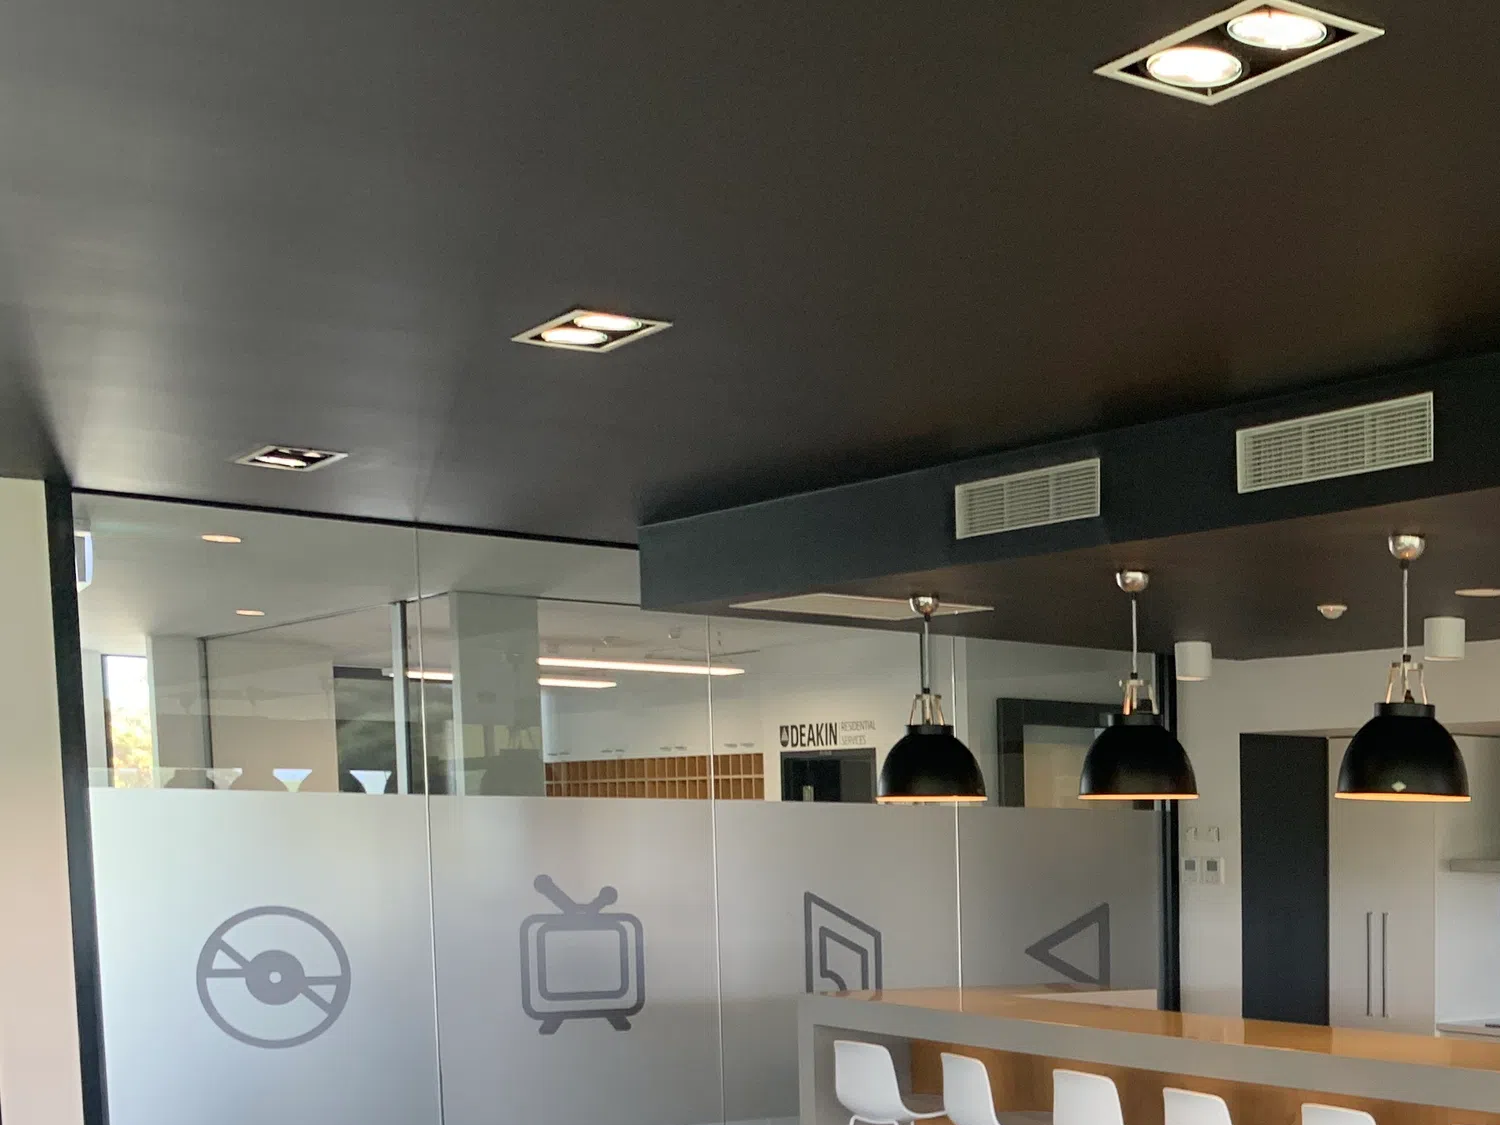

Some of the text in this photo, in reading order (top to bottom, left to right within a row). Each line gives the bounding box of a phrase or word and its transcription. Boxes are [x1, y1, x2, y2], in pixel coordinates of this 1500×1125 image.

[841, 720, 876, 731] RESIDENTIAL
[790, 722, 837, 747] DEAKIN
[841, 735, 866, 745] SERVICES
